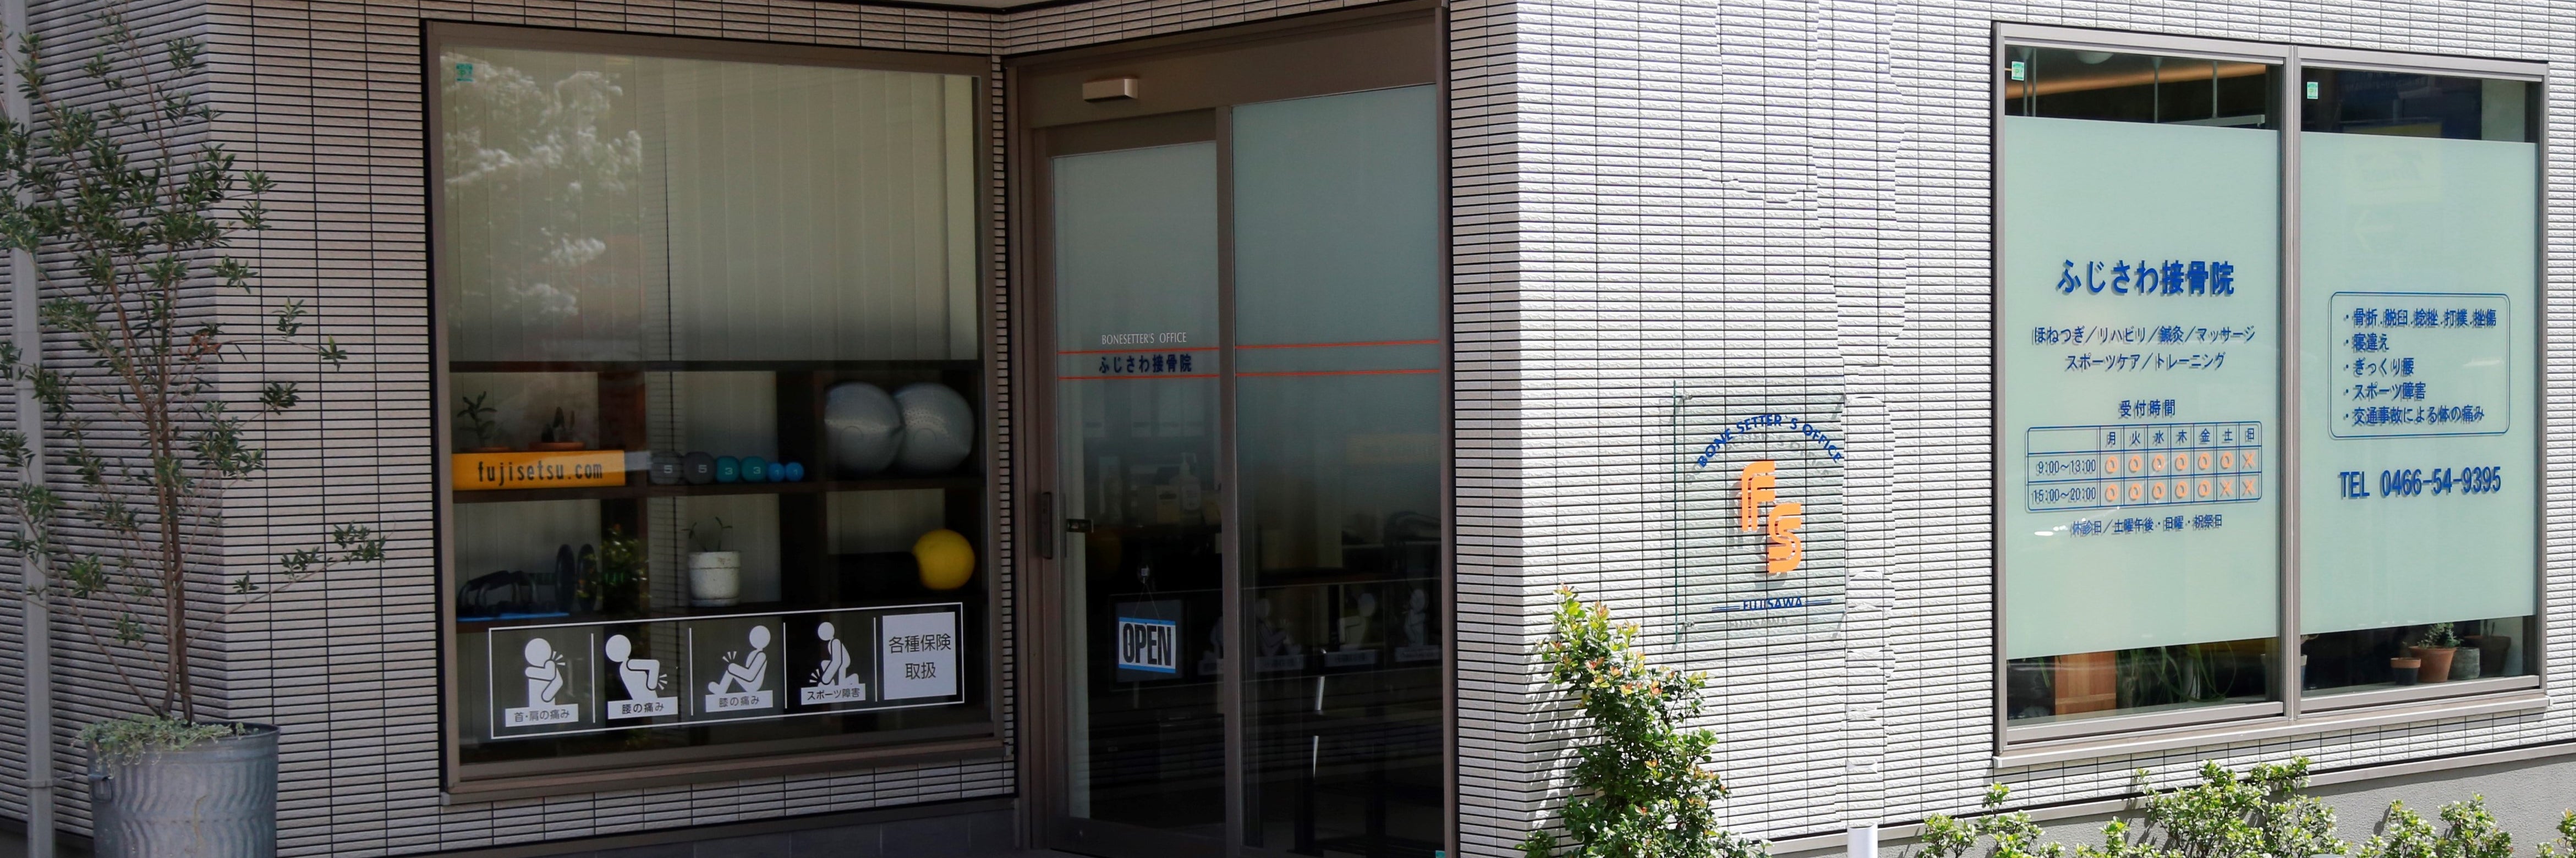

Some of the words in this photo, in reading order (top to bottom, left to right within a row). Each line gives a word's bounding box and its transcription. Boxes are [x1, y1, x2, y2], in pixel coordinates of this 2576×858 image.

[2057, 260, 2235, 295] ふじさわ接骨院
[1102, 333, 1154, 344] BONESETTER'S
[1159, 332, 1187, 343] OFFICE
[1099, 354, 1192, 373] ふじさわ接骨院
[2120, 399, 2175, 417] 受付時間
[2108, 432, 2116, 444] 月
[2132, 431, 2140, 443] 火
[2155, 430, 2164, 443] 水
[2178, 430, 2188, 442] 木
[2201, 428, 2210, 442] 金
[2224, 428, 2233, 441] 土
[2246, 428, 2255, 439] 日
[1697, 429, 1733, 468] BONE
[1802, 424, 1843, 463] OFFICE
[478, 460, 603, 486] fujisetsu.com
[664, 465, 673, 474] 5
[698, 464, 708, 473] 5
[725, 467, 733, 475] 3
[753, 466, 761, 475] 3
[2340, 471, 2370, 497] TEL
[2382, 466, 2501, 496] 0466-54-9395
[1743, 597, 1802, 610] FUJISAWA
[889, 634, 951, 653] 各種保険
[1123, 623, 1171, 666] OPEN
[906, 662, 936, 679] 取扱
[719, 695, 759, 707] 膝の痛み
[807, 688, 860, 700] スポーツ障害
[622, 701, 664, 714] 腰の痛み
